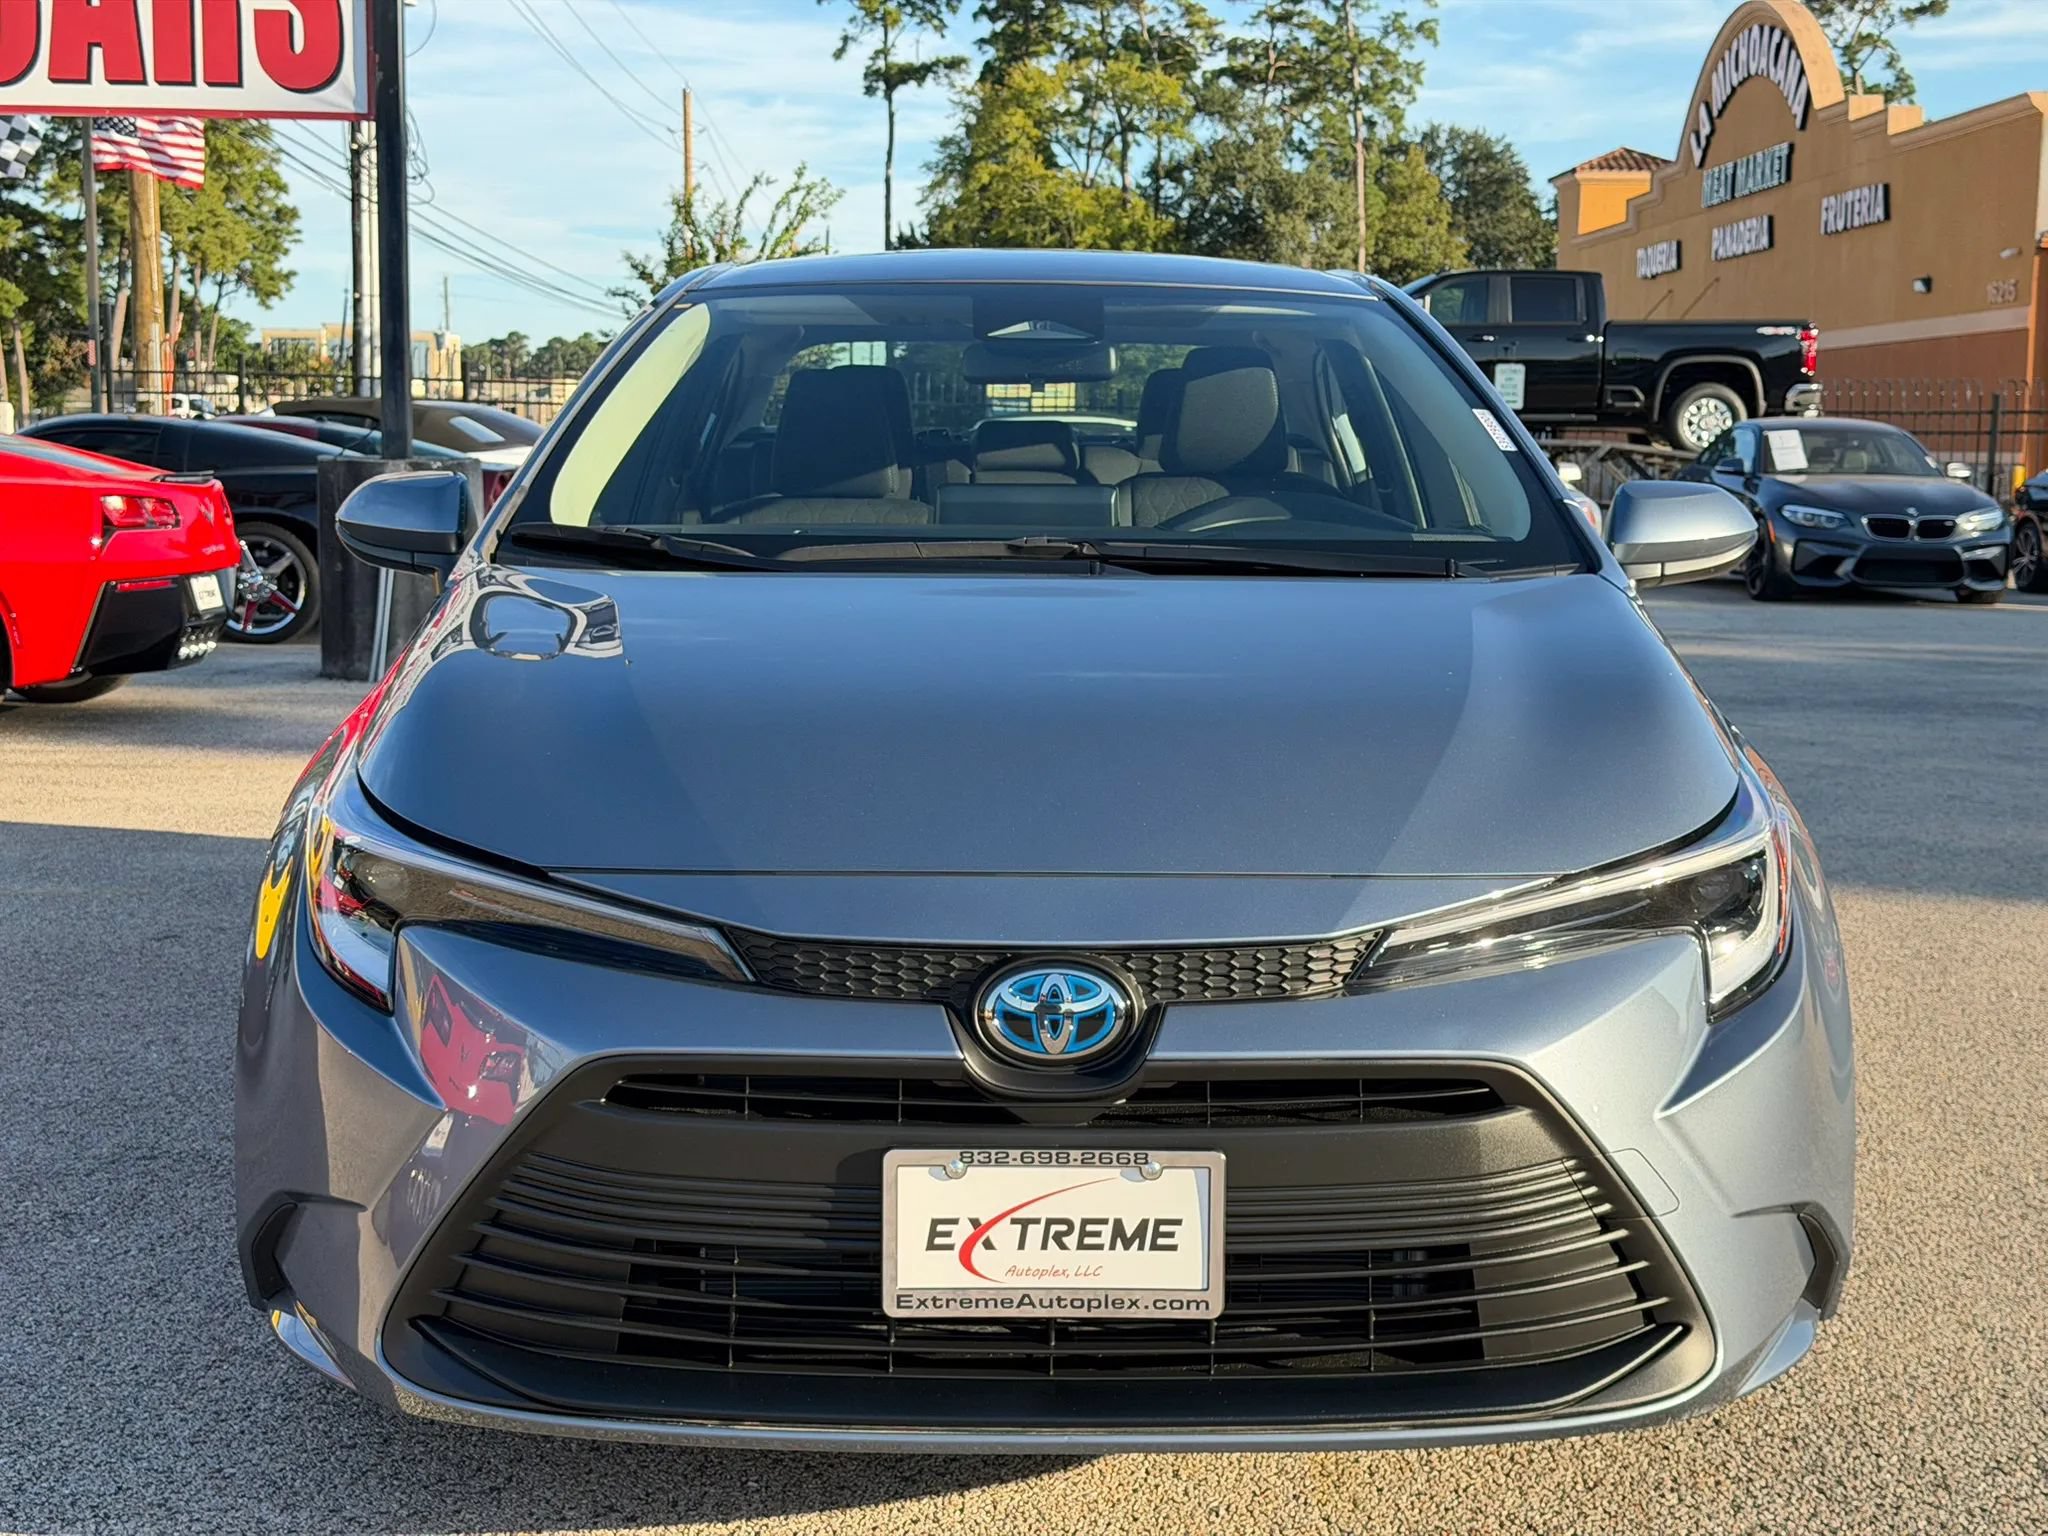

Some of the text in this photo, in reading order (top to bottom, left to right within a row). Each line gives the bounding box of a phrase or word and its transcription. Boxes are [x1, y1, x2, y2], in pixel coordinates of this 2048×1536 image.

[1690, 24, 1810, 168] LA MICHOACANA
[1820, 183, 1889, 236] FRUTERIA
[1711, 214, 1772, 262] PANADERIA
[959, 1151, 1150, 1166] 832-698-2668
[925, 1216, 1184, 1253] EXTREME
[1005, 1264, 1104, 1280] Autoplex, LLC
[896, 1293, 1210, 1313] ExtremeAutoplex.com
